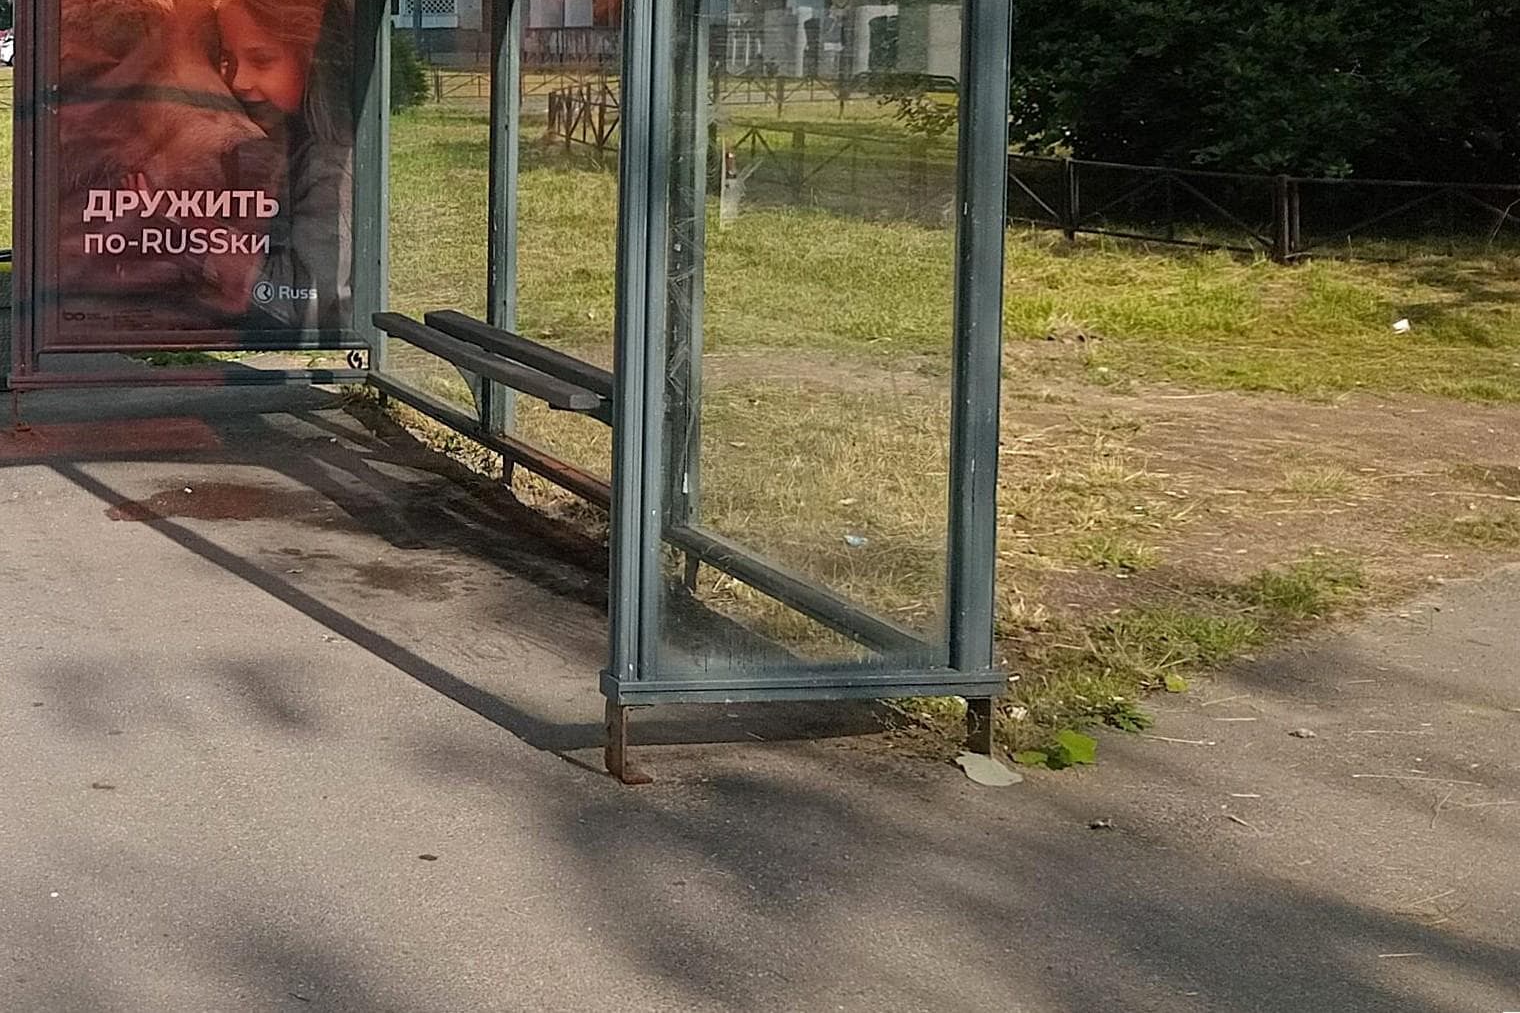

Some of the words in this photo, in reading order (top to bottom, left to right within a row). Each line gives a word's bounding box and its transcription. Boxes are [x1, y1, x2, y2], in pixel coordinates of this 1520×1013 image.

[83, 190, 280, 222] ДРУЖИТЬ
[84, 228, 270, 254] по-RUSSки
[280, 286, 318, 300] Russ
